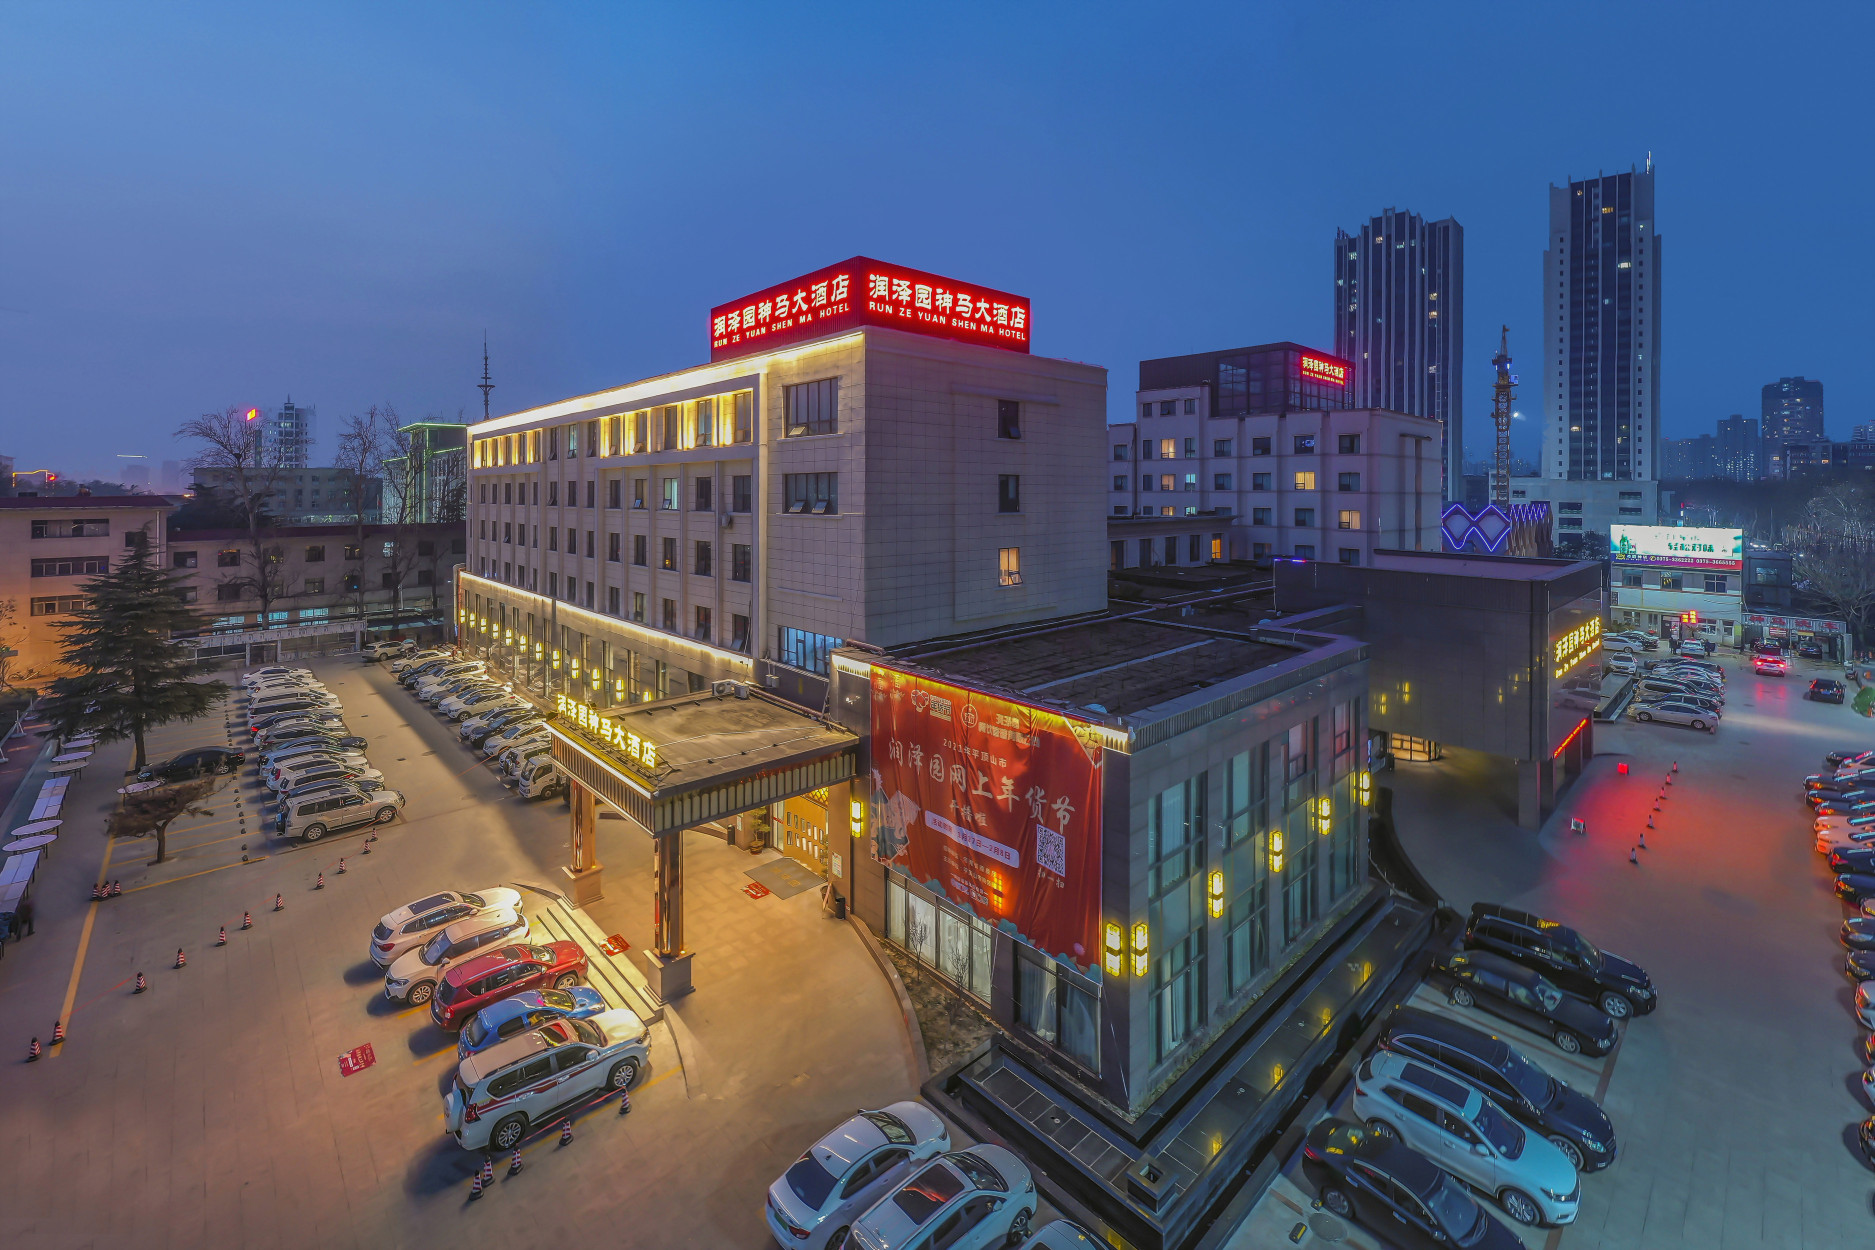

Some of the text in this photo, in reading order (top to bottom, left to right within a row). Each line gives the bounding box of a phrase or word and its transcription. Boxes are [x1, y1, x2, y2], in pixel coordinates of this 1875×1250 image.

[714, 274, 850, 338] 润泽园神马大酒店
[869, 273, 1026, 329] 润泽园神马大酒店
[869, 301, 1026, 342] RUN ZE YUAN SHEN MA HOTEL
[714, 302, 850, 348] RUN ZE YUAN SHEN MA HOTEL
[1303, 357, 1344, 378] 润泽园神马大酒店
[1668, 542, 1714, 553] 轻松对味
[1555, 616, 1600, 663] 润泽园神马大酒店
[557, 693, 656, 769] 润泽园神马大酒店
[943, 738, 1008, 768] 2021年平顶山市
[888, 736, 1076, 834] 润泽园网上年货节
[1038, 867, 1065, 889] 扫一扫
